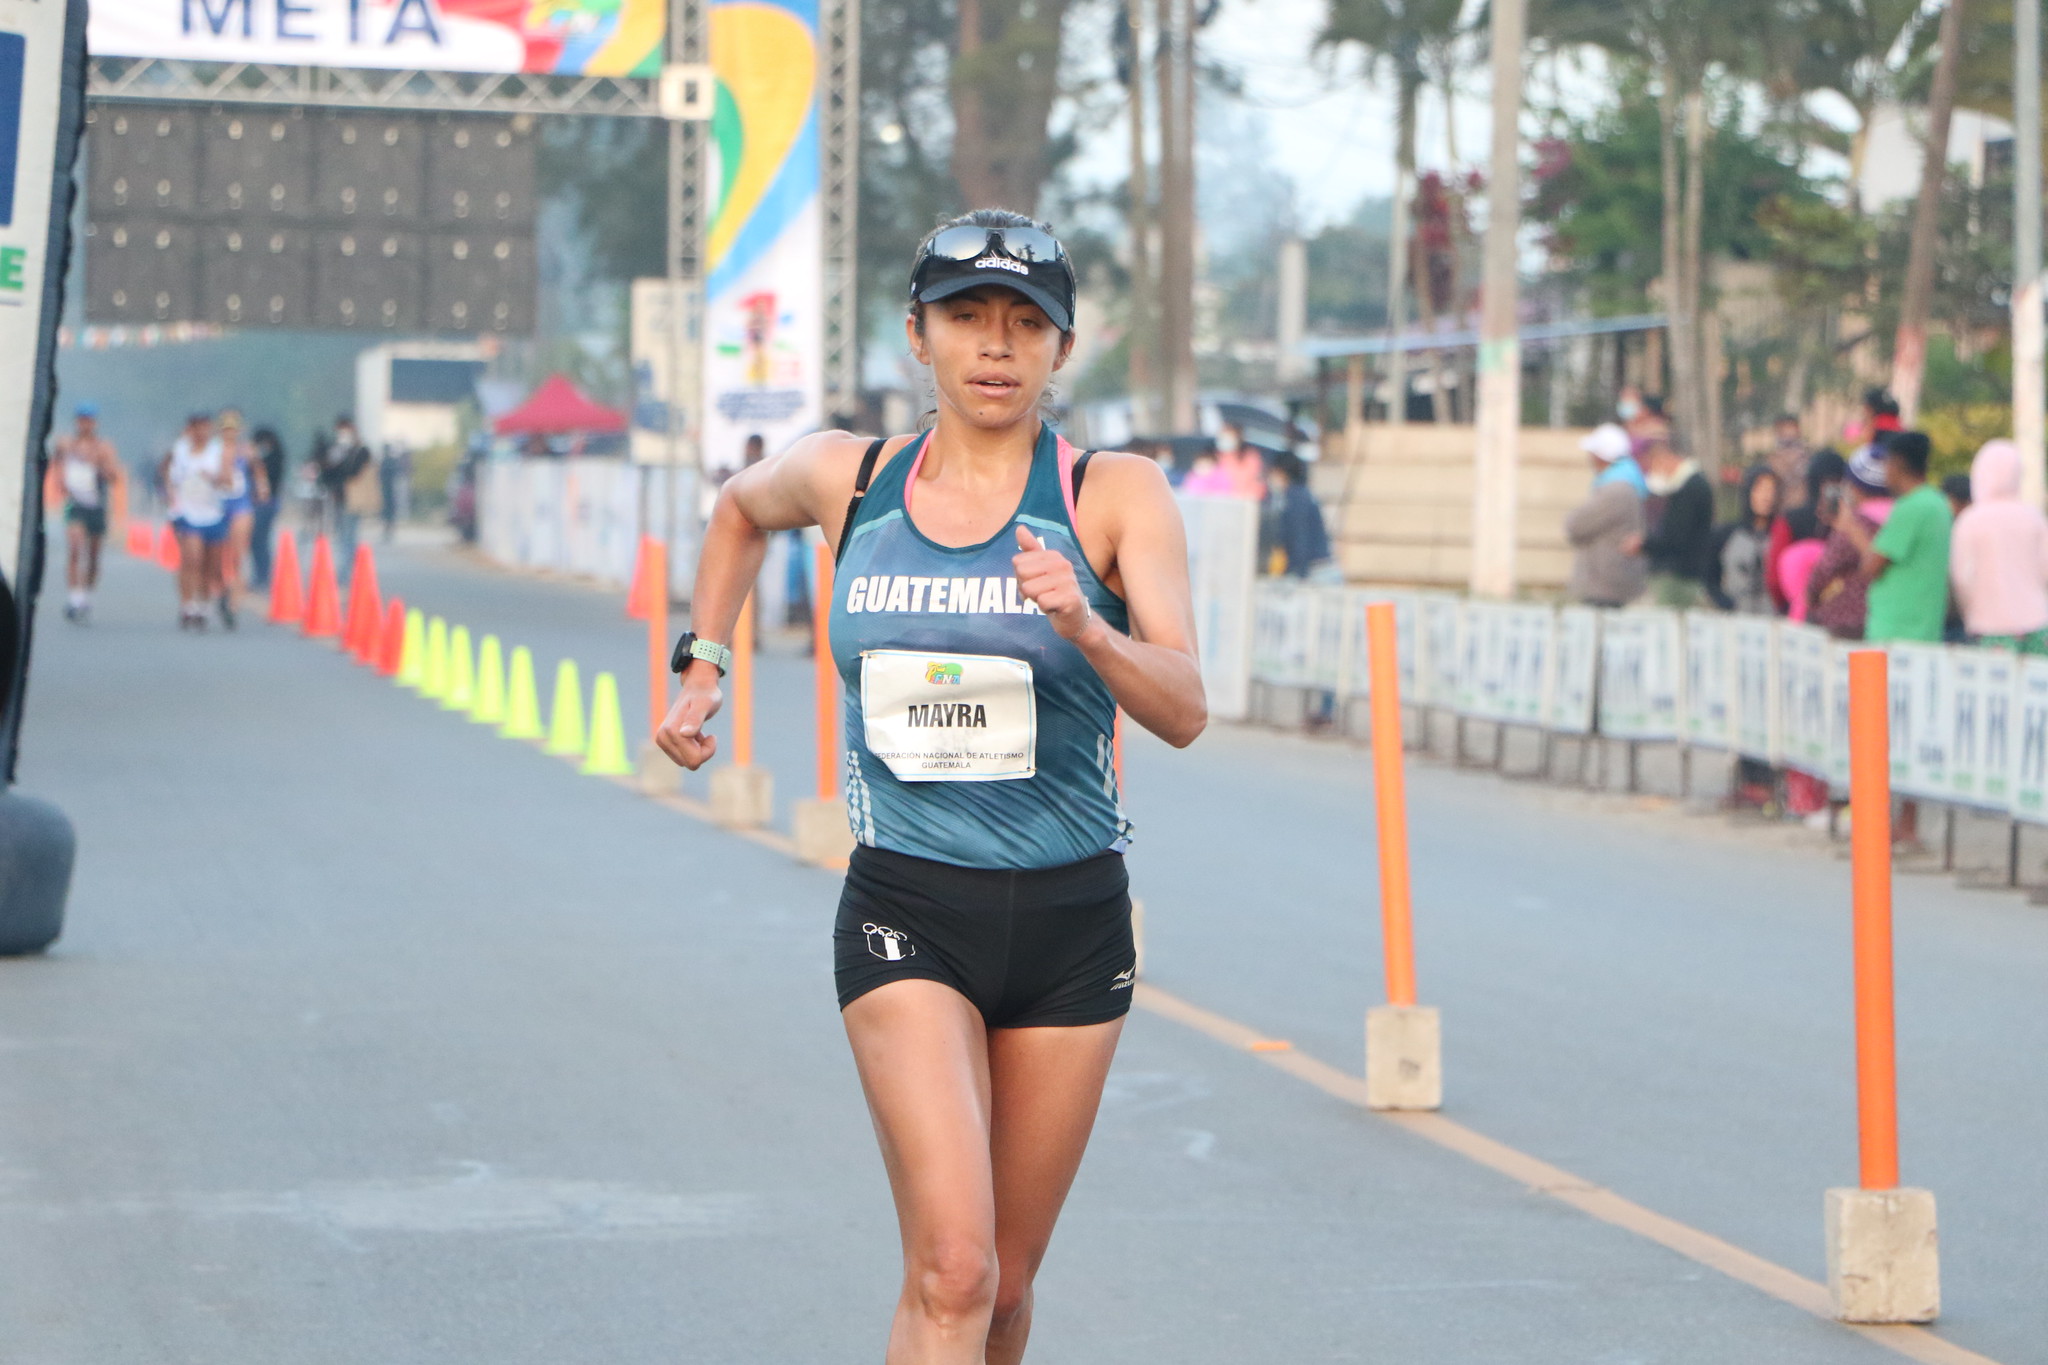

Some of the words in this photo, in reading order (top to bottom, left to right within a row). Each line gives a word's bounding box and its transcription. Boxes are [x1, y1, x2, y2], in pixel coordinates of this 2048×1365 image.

[975, 257, 1029, 275] adidas
[907, 703, 987, 729] MAYRA
[923, 752, 964, 760] NACIONAL
[966, 752, 978, 760] DE
[979, 752, 1025, 760] ATLETISMO
